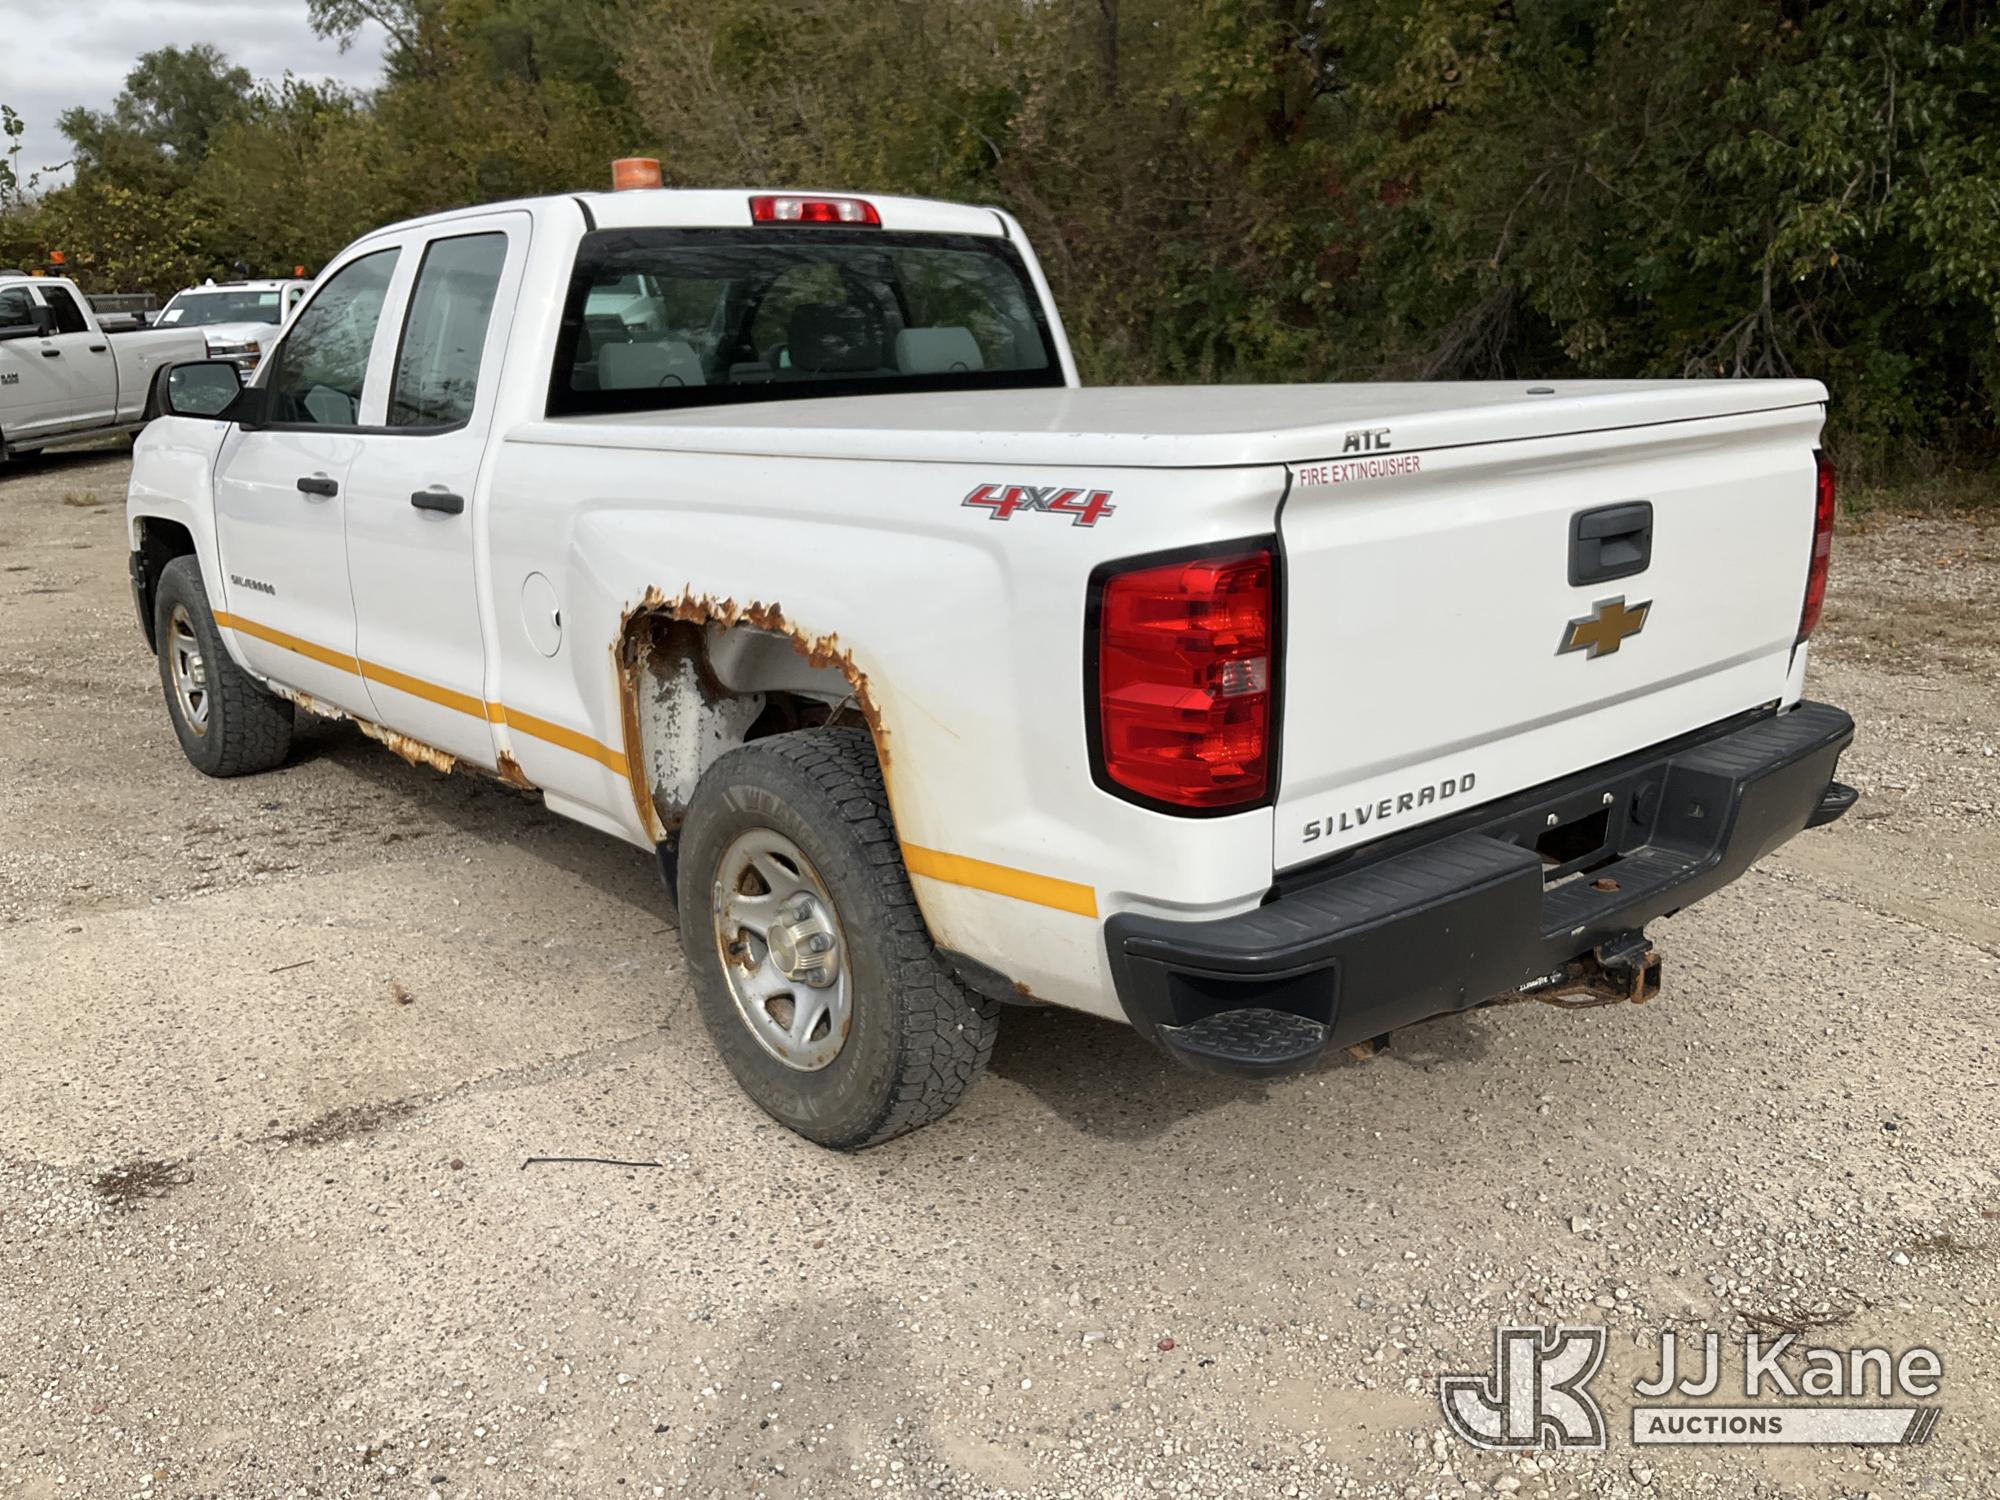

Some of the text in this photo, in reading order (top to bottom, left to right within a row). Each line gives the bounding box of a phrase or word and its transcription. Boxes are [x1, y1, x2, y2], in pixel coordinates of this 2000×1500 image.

[1342, 427, 1391, 452] ATC
[1300, 456, 1421, 487] FIRE EXTINGUISHER
[1303, 773, 1476, 843] SILVERADO
